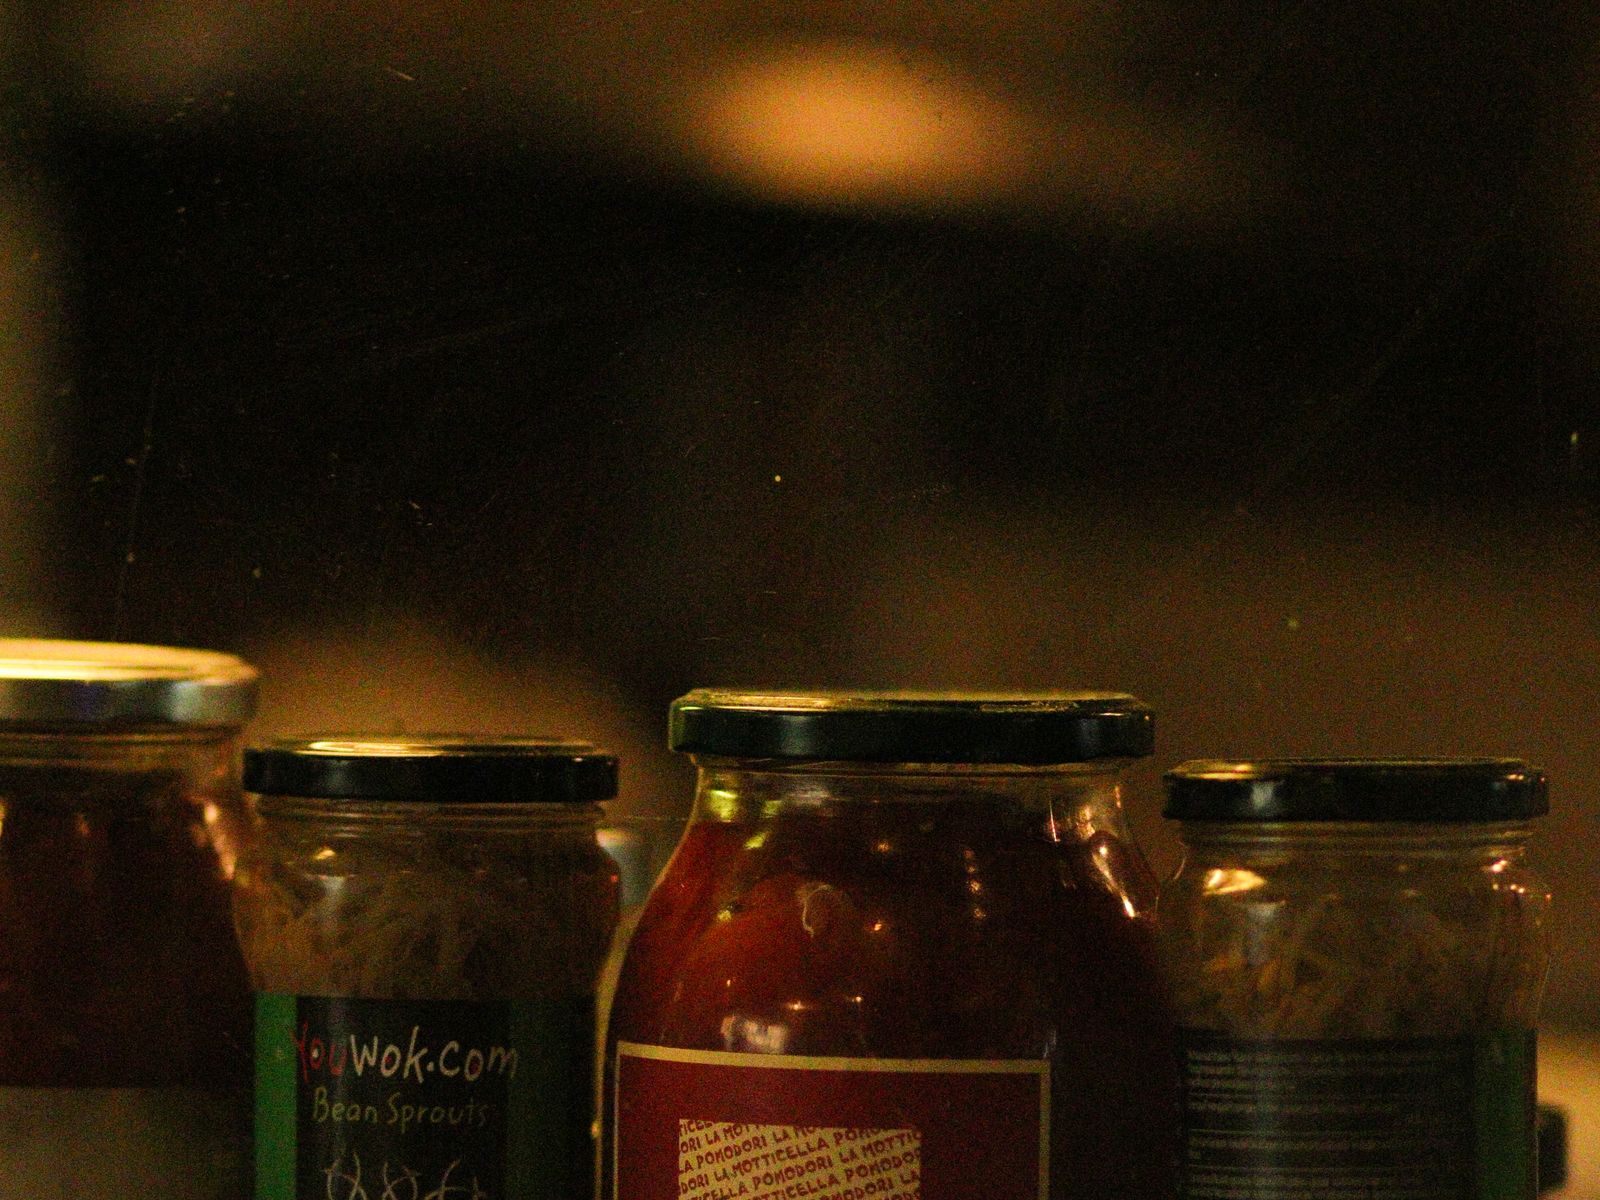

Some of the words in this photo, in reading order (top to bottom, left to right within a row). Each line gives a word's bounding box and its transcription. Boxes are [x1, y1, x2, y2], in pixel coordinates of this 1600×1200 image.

[312, 1085, 379, 1124] Bean
[386, 1091, 492, 1135] Sprouts
[696, 1135, 768, 1170] POMODORI
[772, 1129, 791, 1143] LA
[705, 1131, 721, 1145] LA
[714, 1168, 731, 1182] LA
[732, 1137, 831, 1177] MOTTICELLA
[752, 1155, 833, 1191] POMODORI
[839, 1149, 860, 1164] LA
